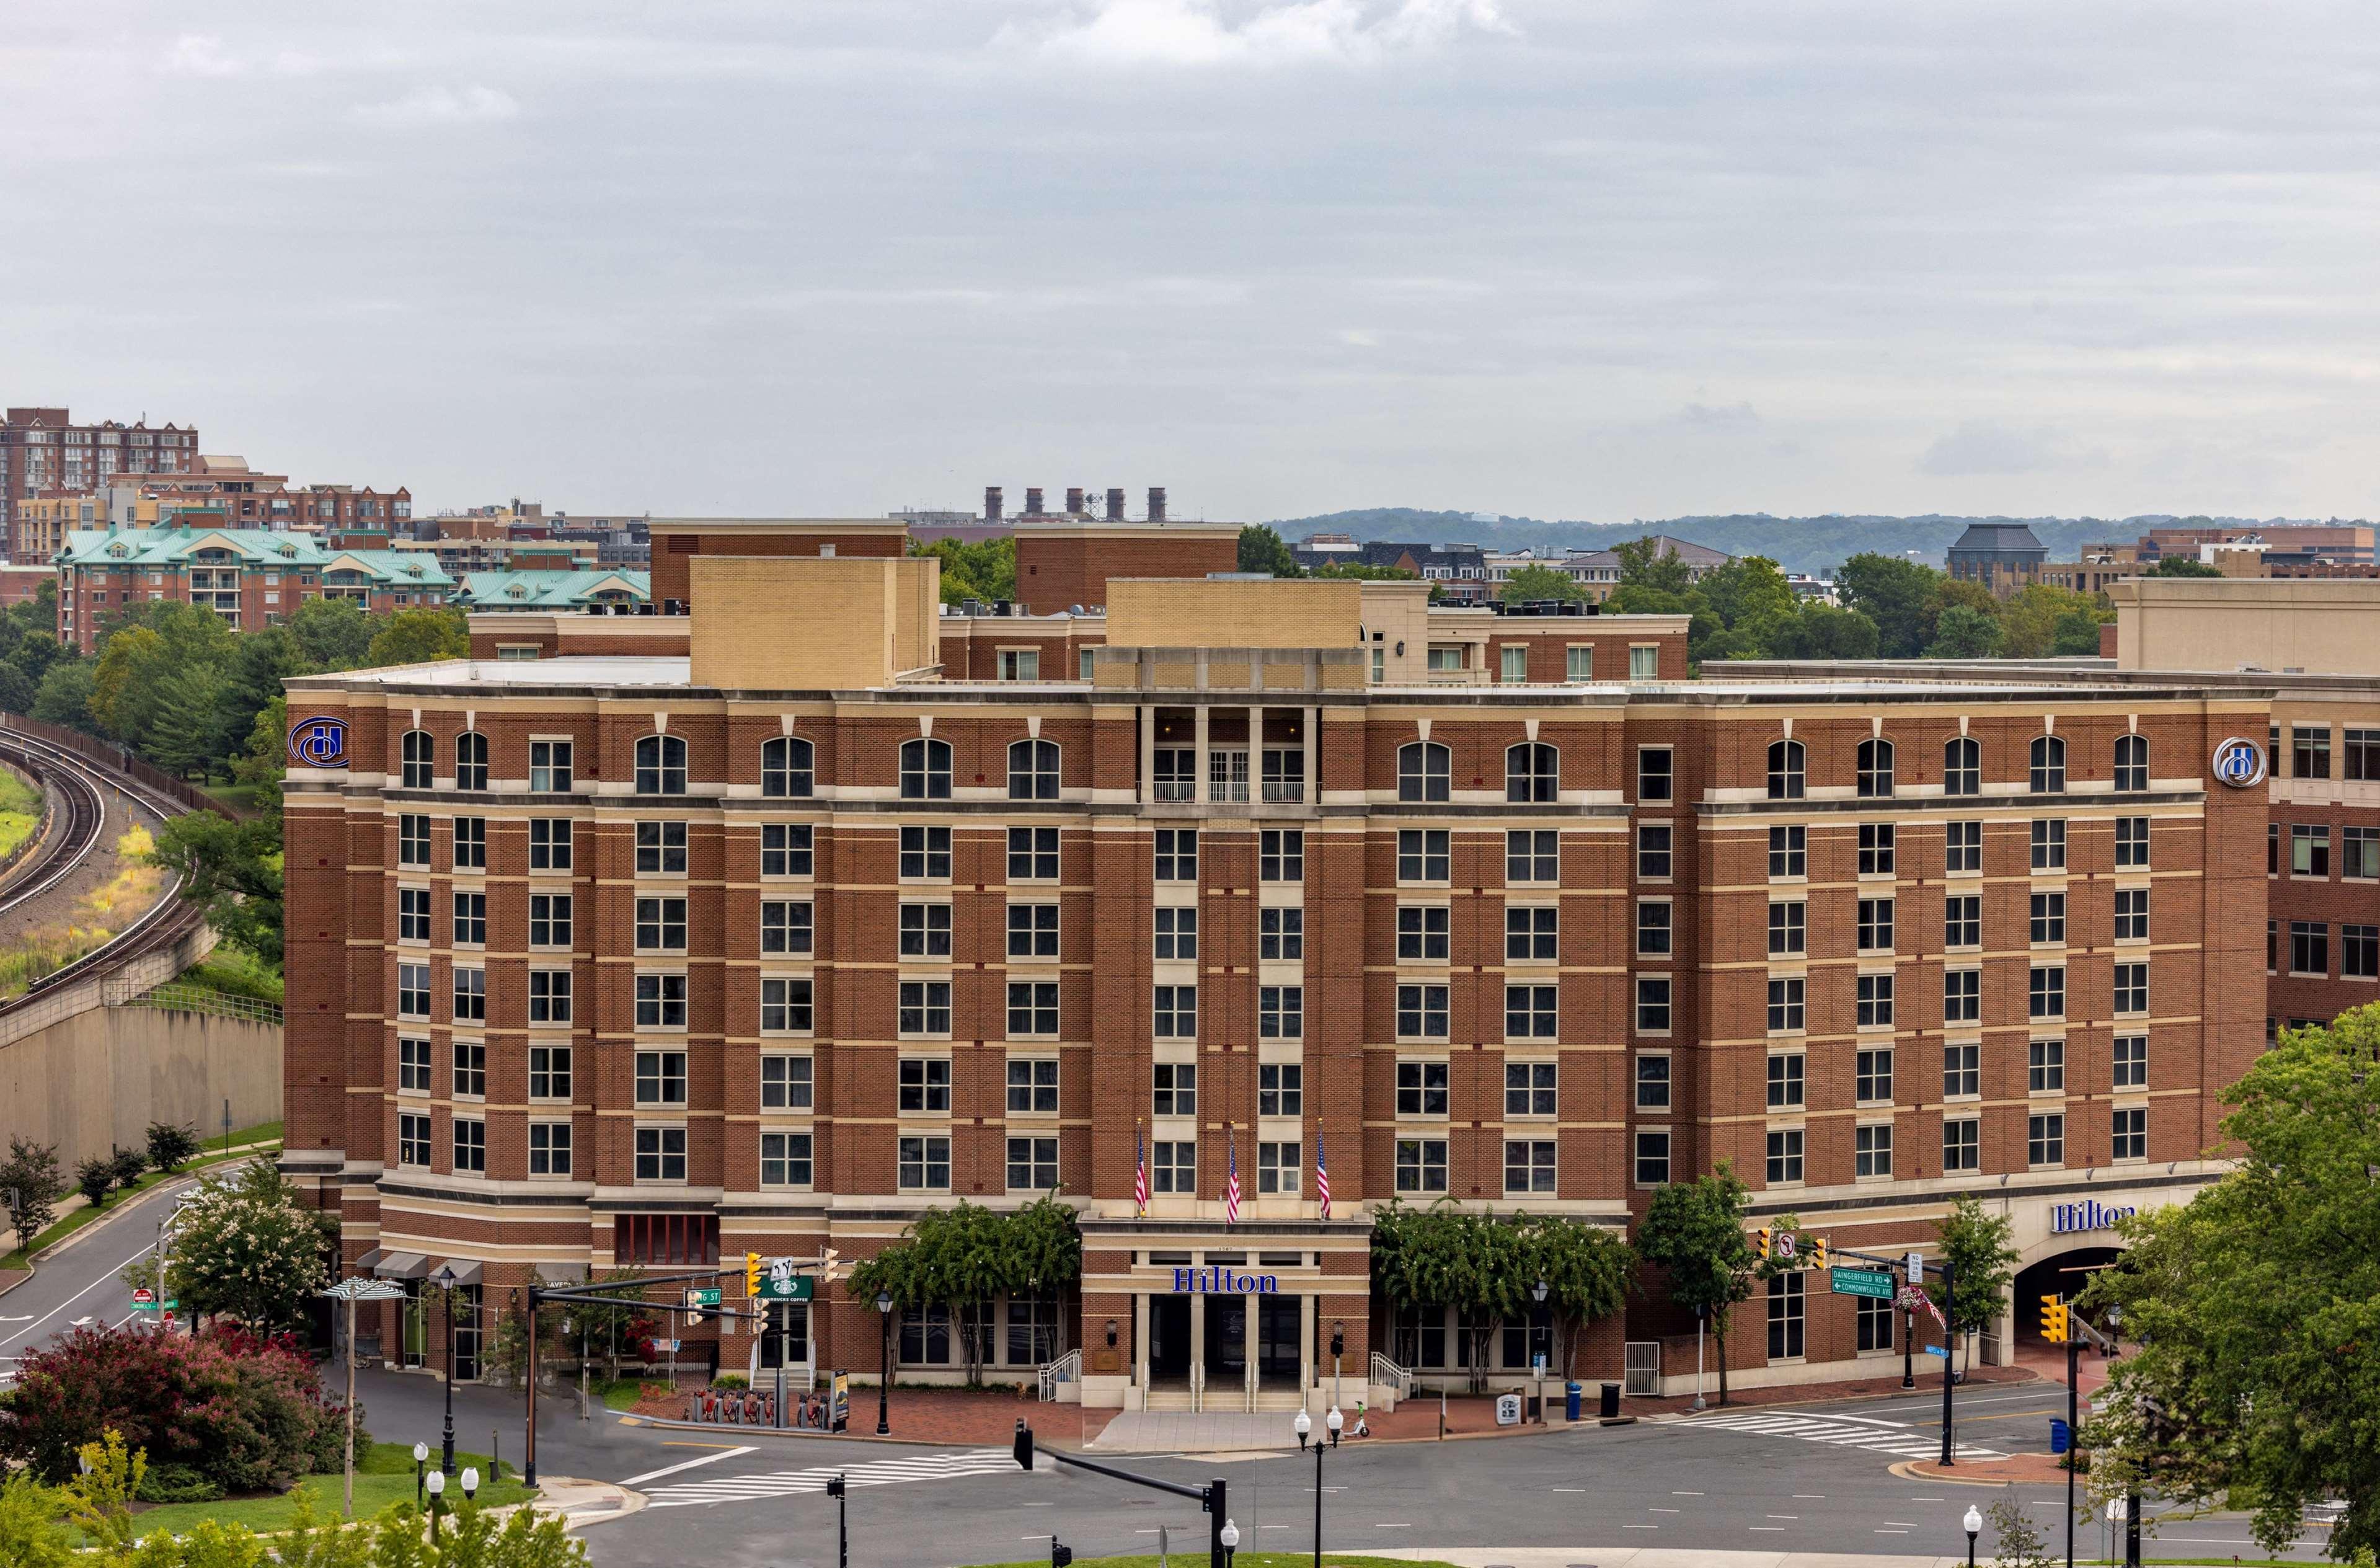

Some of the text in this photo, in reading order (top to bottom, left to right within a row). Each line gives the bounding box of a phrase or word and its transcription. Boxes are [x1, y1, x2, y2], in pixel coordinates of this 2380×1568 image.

[1172, 1265, 1279, 1293] Hilton
[1833, 1271, 1873, 1282] DAINGERFIELD
[1842, 1283, 1880, 1295] COMMONWEALTH
